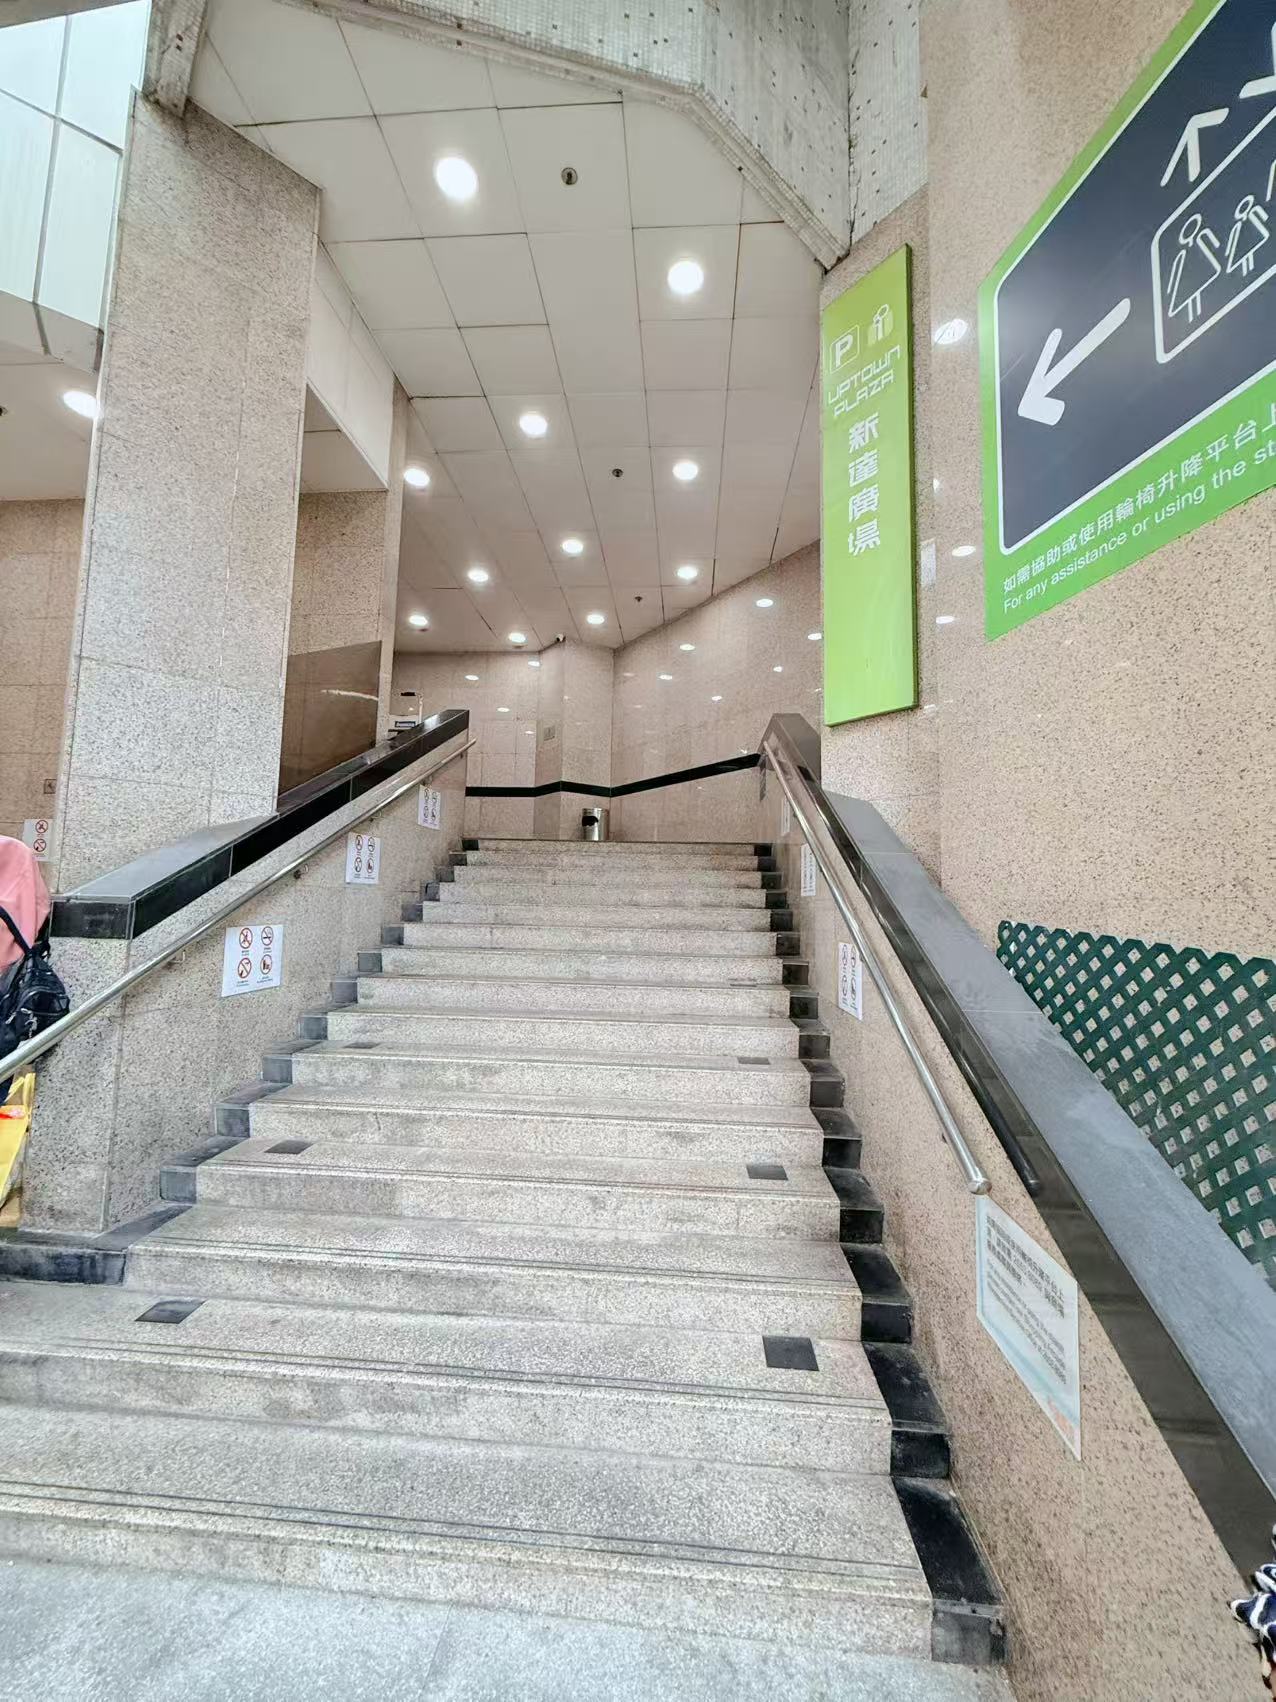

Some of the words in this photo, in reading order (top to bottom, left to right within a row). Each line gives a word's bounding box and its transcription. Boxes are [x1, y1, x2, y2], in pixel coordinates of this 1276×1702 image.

[828, 344, 900, 404] UPTOWN
[835, 333, 854, 368] P
[834, 369, 894, 417] PLAZA
[847, 411, 880, 556] 新達廣場
[1003, 594, 1024, 614] For
[1025, 579, 1048, 600] any
[1050, 532, 1128, 585] assistance
[1132, 517, 1149, 537] or
[1154, 484, 1206, 524] using
[1212, 460, 1247, 489] the
